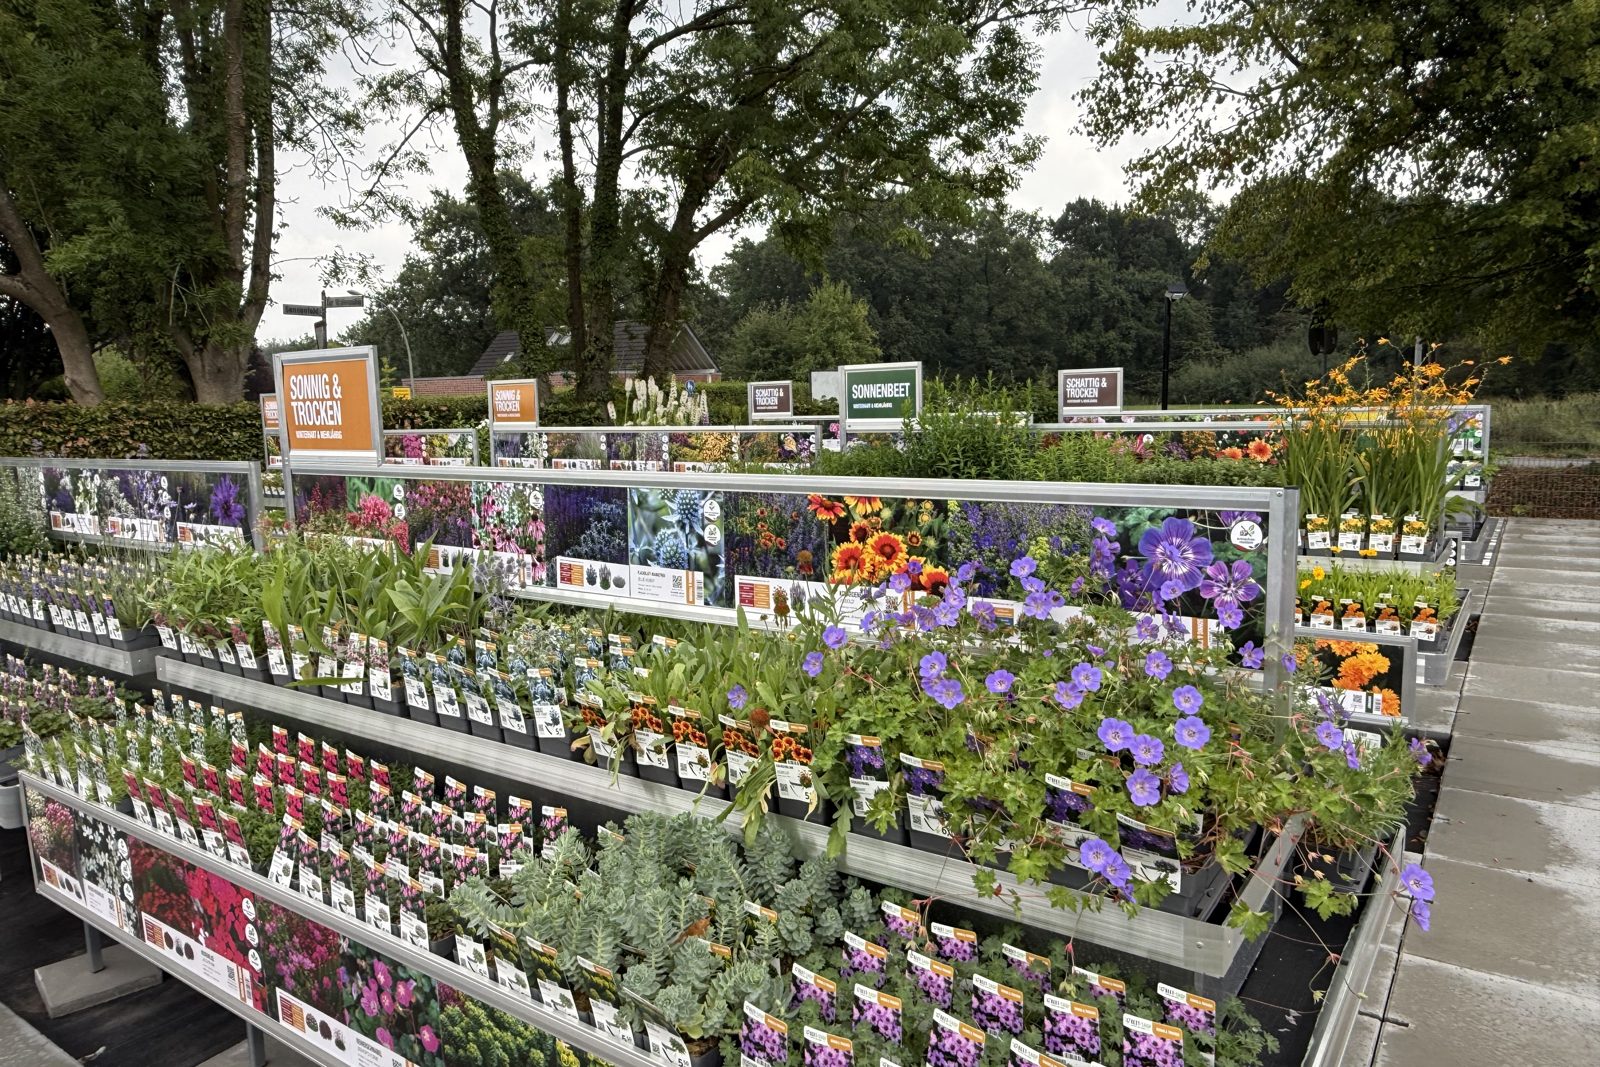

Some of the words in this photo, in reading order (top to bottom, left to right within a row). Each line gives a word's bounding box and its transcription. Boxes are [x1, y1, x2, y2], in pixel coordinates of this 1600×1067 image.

[290, 373, 331, 399] SONNIG
[332, 373, 342, 399] &
[1066, 377, 1100, 388] SCHATTIG
[1101, 377, 1107, 388] &
[755, 388, 778, 397] SCHATTIG
[852, 382, 910, 399] SONNENBEET
[1066, 387, 1099, 398] TROCKEN
[495, 400, 520, 412] TROCKEN
[291, 400, 342, 426] TROCKEN
